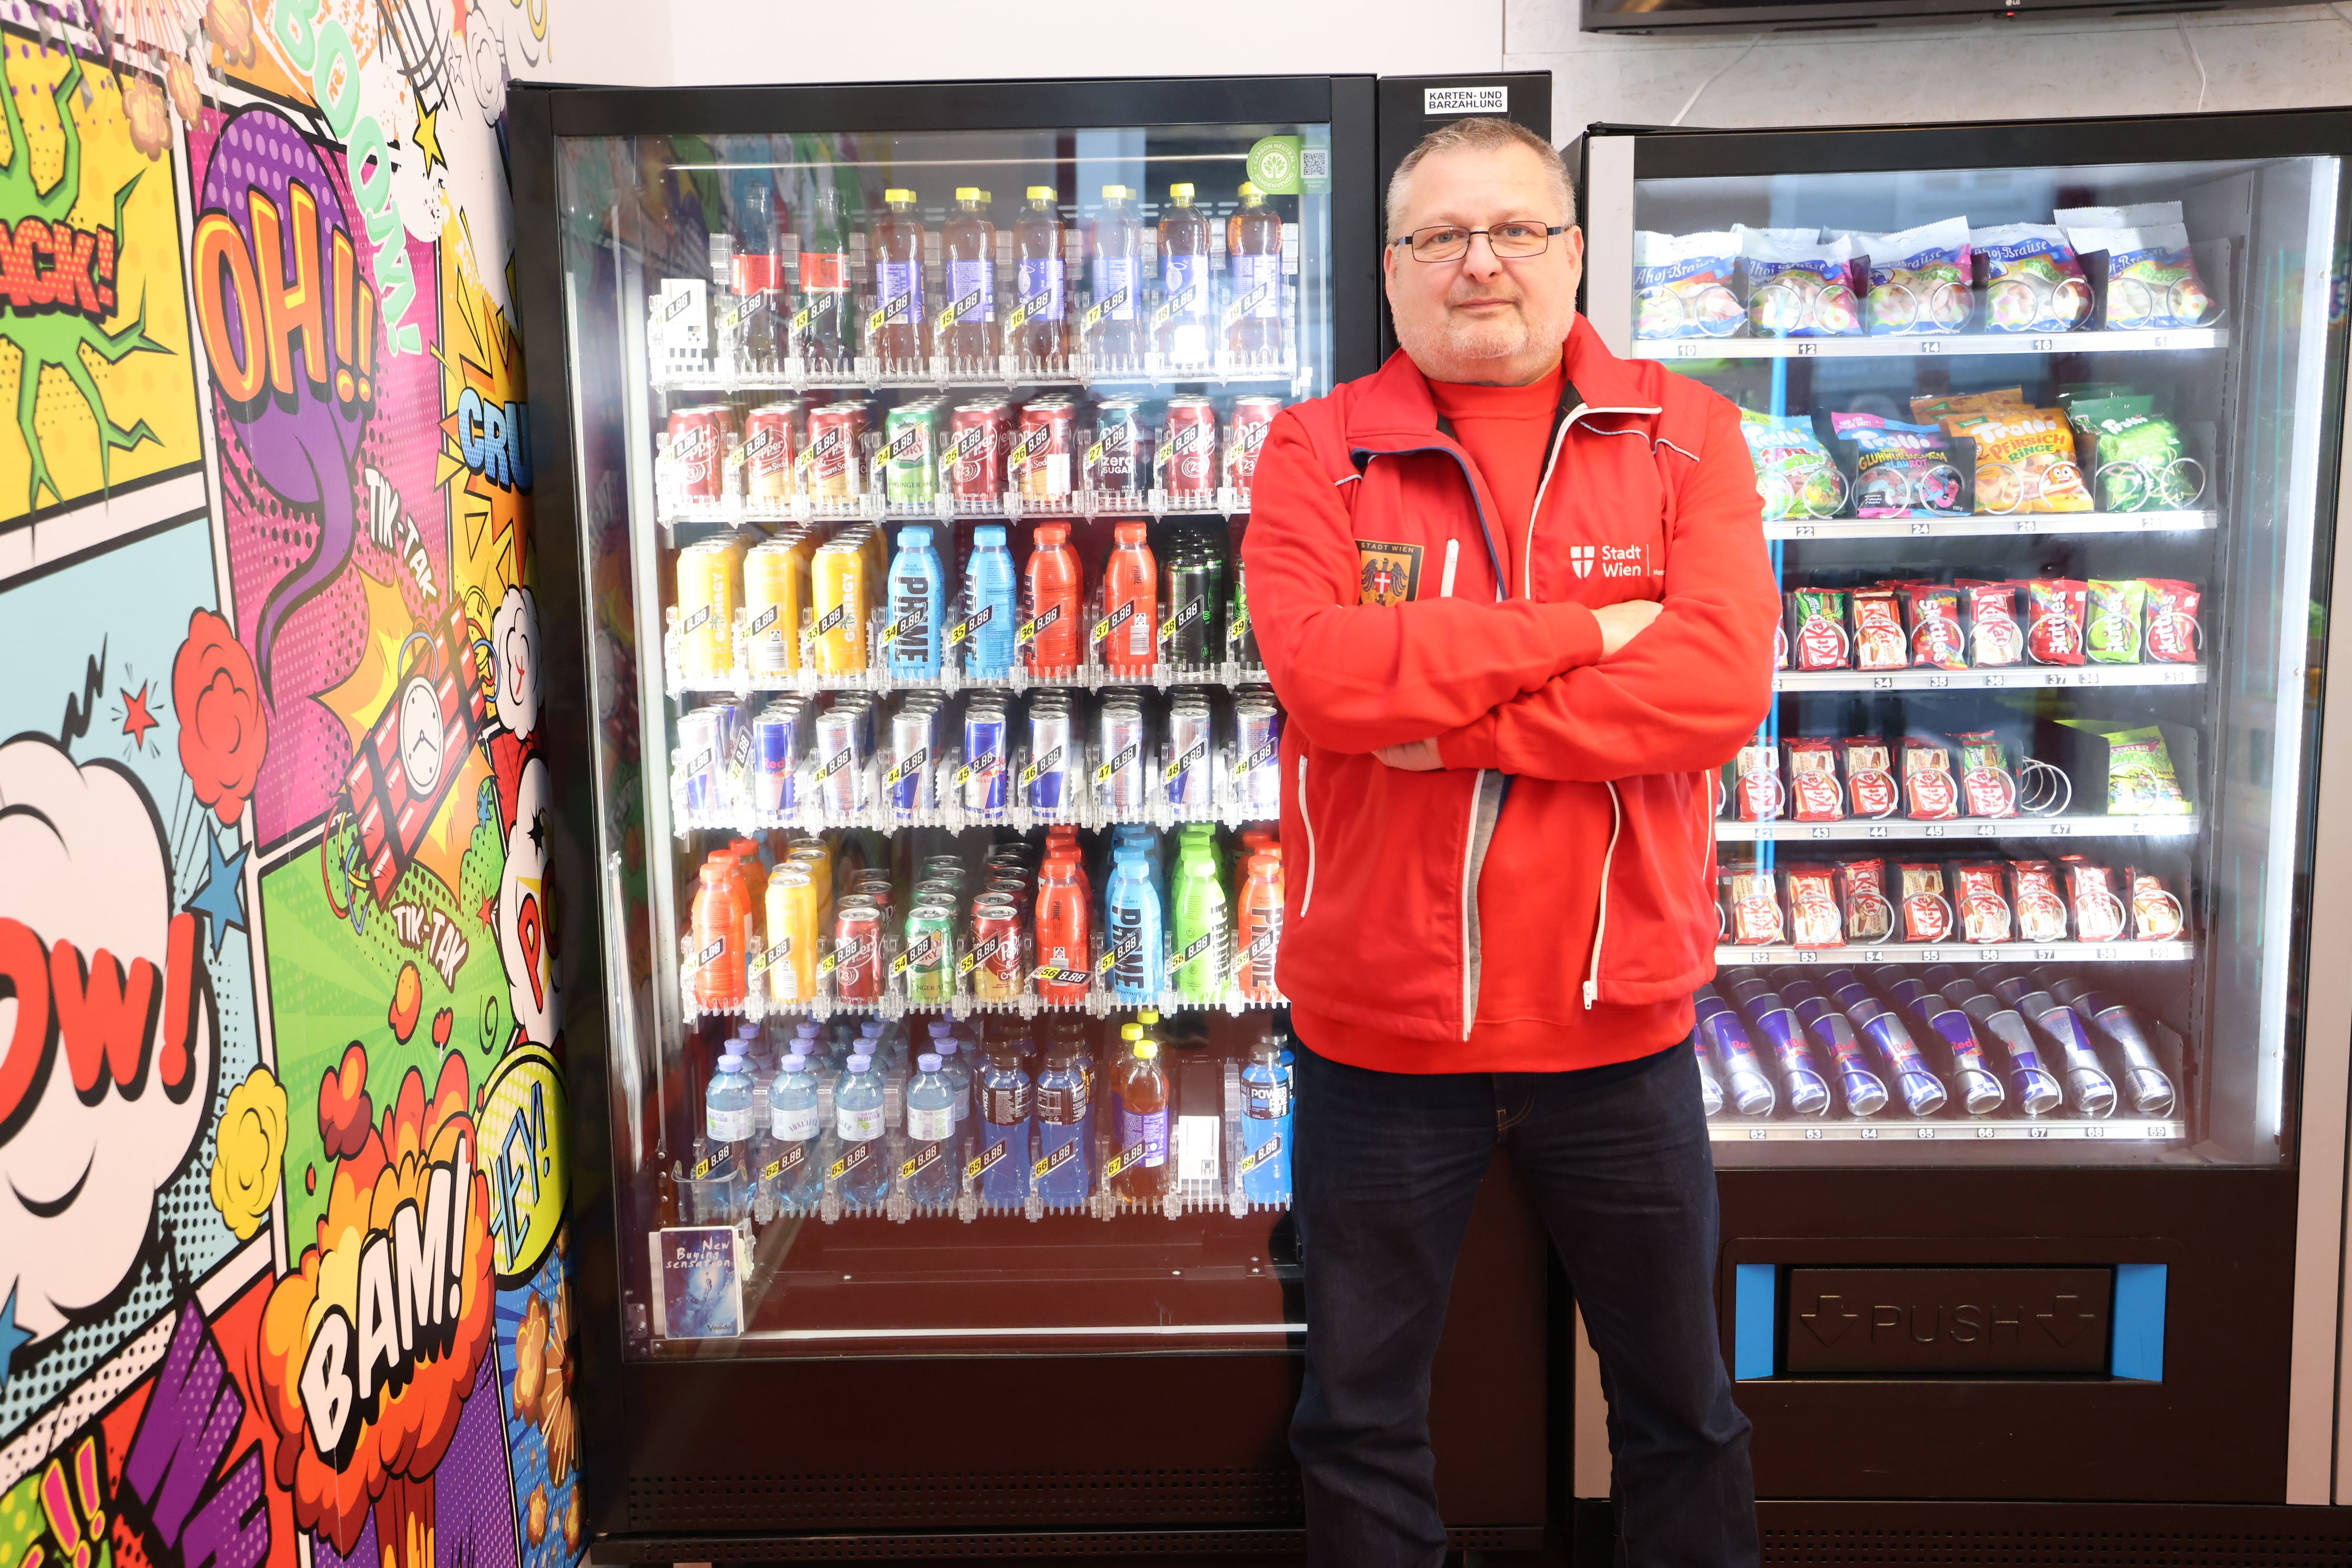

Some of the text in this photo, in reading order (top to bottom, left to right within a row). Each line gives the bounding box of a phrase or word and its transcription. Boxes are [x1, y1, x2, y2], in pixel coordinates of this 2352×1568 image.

[1429, 92, 1477, 100] KARTEN-
[1429, 100, 1502, 109] BARZAHLUNG
[1253, 143, 1296, 163] CARBON NEUTRAL
[1255, 173, 1294, 189] SANDENVENDO
[195, 181, 375, 404] OH!!
[795, 295, 831, 327] 13 8.88
[872, 295, 908, 326] 14 8.88
[941, 293, 978, 325] 15 8.88
[1011, 292, 1048, 325] 16 8.88
[1088, 290, 1124, 322] 17 8.88
[1680, 346, 1695, 355] 10
[1800, 345, 1815, 354] 12
[1924, 343, 1939, 352] 14
[2035, 340, 2051, 349] 16
[1852, 430, 1930, 449] Trolli
[1972, 419, 2057, 443] Trolli
[802, 432, 836, 465] 23 8.88
[877, 432, 912, 465] 24 8.88
[946, 431, 981, 464] 25 8.88
[1014, 429, 1047, 463] 26 8.88
[1090, 427, 1124, 462] 27 8.88
[1161, 426, 1195, 460] 28 8.88
[1103, 455, 1134, 466] zero
[365, 468, 437, 600] TIK-TAK
[1913, 525, 1929, 533] 24
[2019, 522, 2034, 530] 26
[1361, 542, 1388, 550] STADT
[1602, 544, 1641, 560] Stadt
[1133, 566, 1142, 585] PRIME
[1602, 562, 1641, 577] Wien
[807, 609, 841, 642] 33 8.88
[885, 611, 920, 641] 34 8.88
[894, 576, 929, 663] PRME
[953, 609, 989, 641] 35 8.88
[1021, 608, 1057, 639] 36 8.88
[1097, 604, 1131, 637] 37 8.88
[1164, 603, 1197, 635] 38 8.88
[1876, 678, 1891, 687] 34
[1987, 677, 2003, 685] 36
[815, 751, 848, 783] 43 8.88
[889, 751, 923, 783] 44 8.88
[1024, 750, 1058, 781] 46 8.88
[1098, 748, 1133, 778] 47 8.88
[1813, 828, 1828, 837] 43
[1927, 827, 1942, 835] 45
[1979, 826, 1993, 834] 46
[2054, 825, 2069, 833] 47
[392, 905, 466, 987] TIK-TAK
[961, 939, 995, 970] 55 8.88
[1102, 936, 1136, 968] 57 8.88
[1172, 935, 1207, 967] 58 8.88
[1923, 951, 1938, 959] 55
[1983, 951, 1997, 959] 56
[2038, 950, 2053, 958] 57
[823, 941, 857, 972] 53 8.88
[895, 940, 928, 972] 54 8.88
[1753, 953, 1768, 962] 52
[1801, 952, 1816, 961] 53
[1866, 952, 1882, 960] 54
[1041, 968, 1085, 982] 56 8.88
[1893, 1039, 1914, 1054] Bull
[1750, 1130, 1765, 1139] 62
[1806, 1130, 1821, 1138] 63
[1862, 1129, 1877, 1138] 64
[1919, 1129, 1933, 1138] 65
[1978, 1129, 1993, 1137] 66
[2087, 1128, 2102, 1136] 68
[2150, 1128, 2165, 1136] 69
[697, 1146, 730, 1175] 61 8.88
[767, 1147, 801, 1177] 62 8.88
[832, 1145, 866, 1175] 63 8.88
[903, 1145, 936, 1175] 64 8.88
[970, 1144, 1003, 1174] 65 8.88
[1109, 1144, 1142, 1174] 67 8.88
[702, 1236, 730, 1251] New
[666, 1259, 731, 1268] sensation
[677, 1248, 719, 1263] Buying
[301, 1133, 469, 1452] BAM!
[706, 1323, 731, 1332] Vendo
[1871, 1305, 2023, 1343] PUSH
